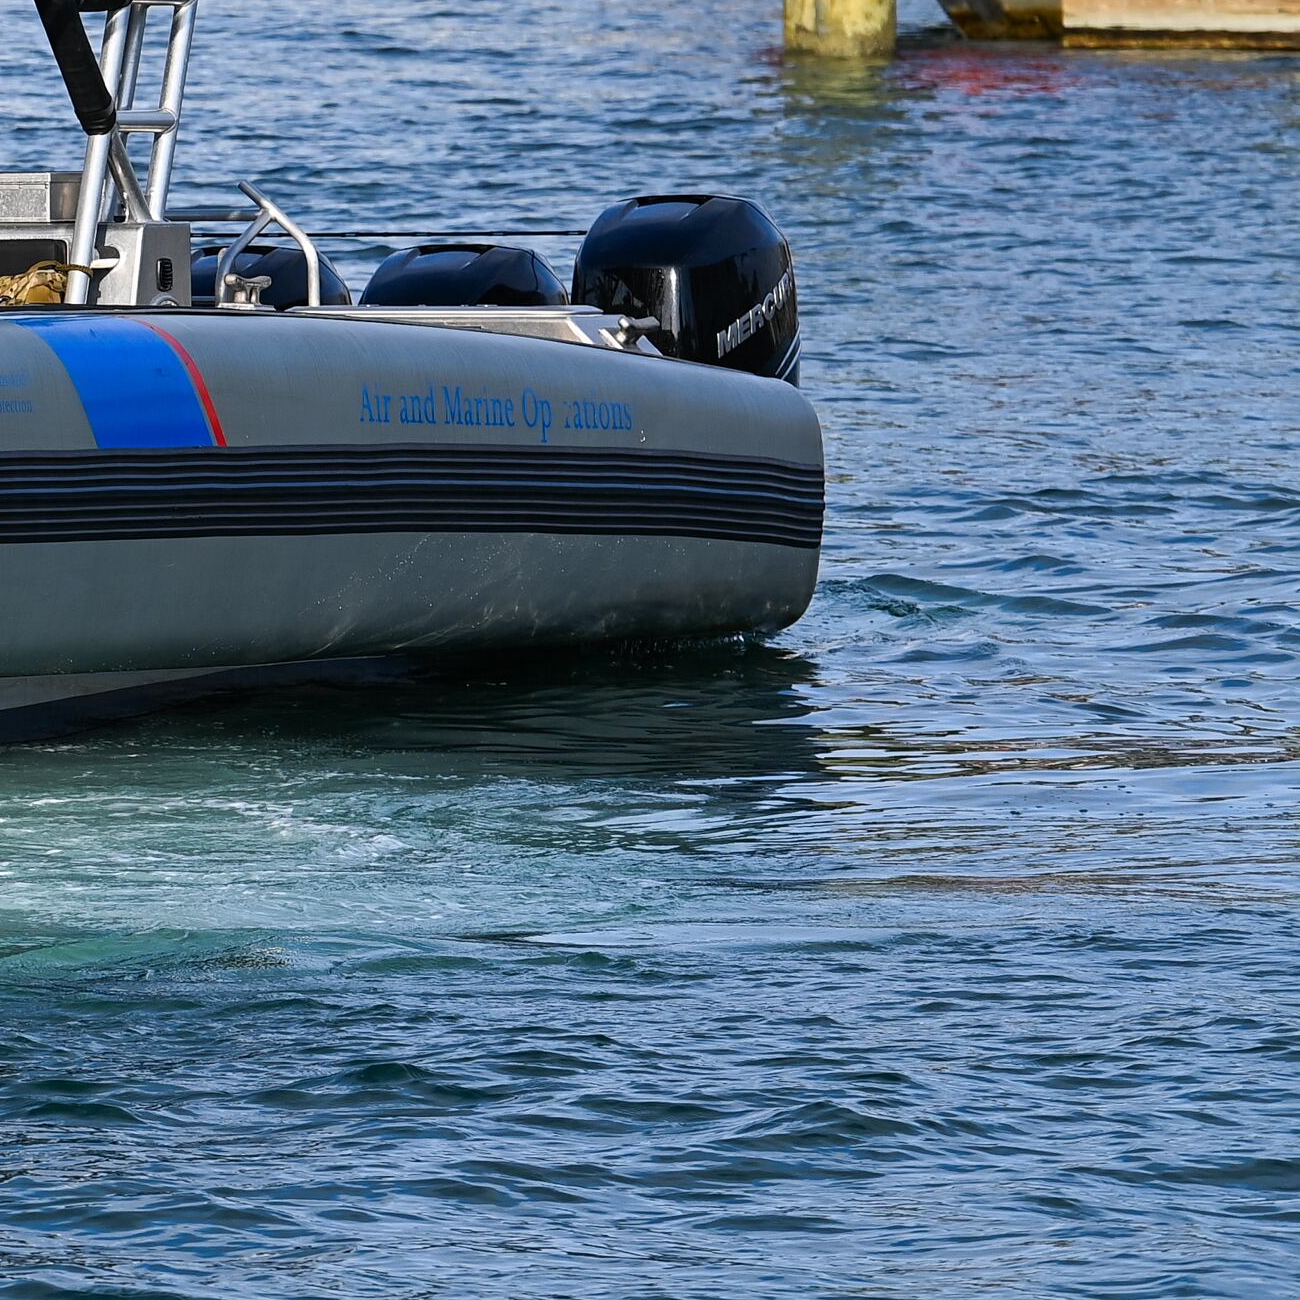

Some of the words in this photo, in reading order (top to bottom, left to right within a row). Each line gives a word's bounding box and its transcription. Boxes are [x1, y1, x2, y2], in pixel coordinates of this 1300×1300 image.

[359, 381, 393, 424] Air
[400, 379, 437, 424] and
[443, 385, 516, 428] Marine
